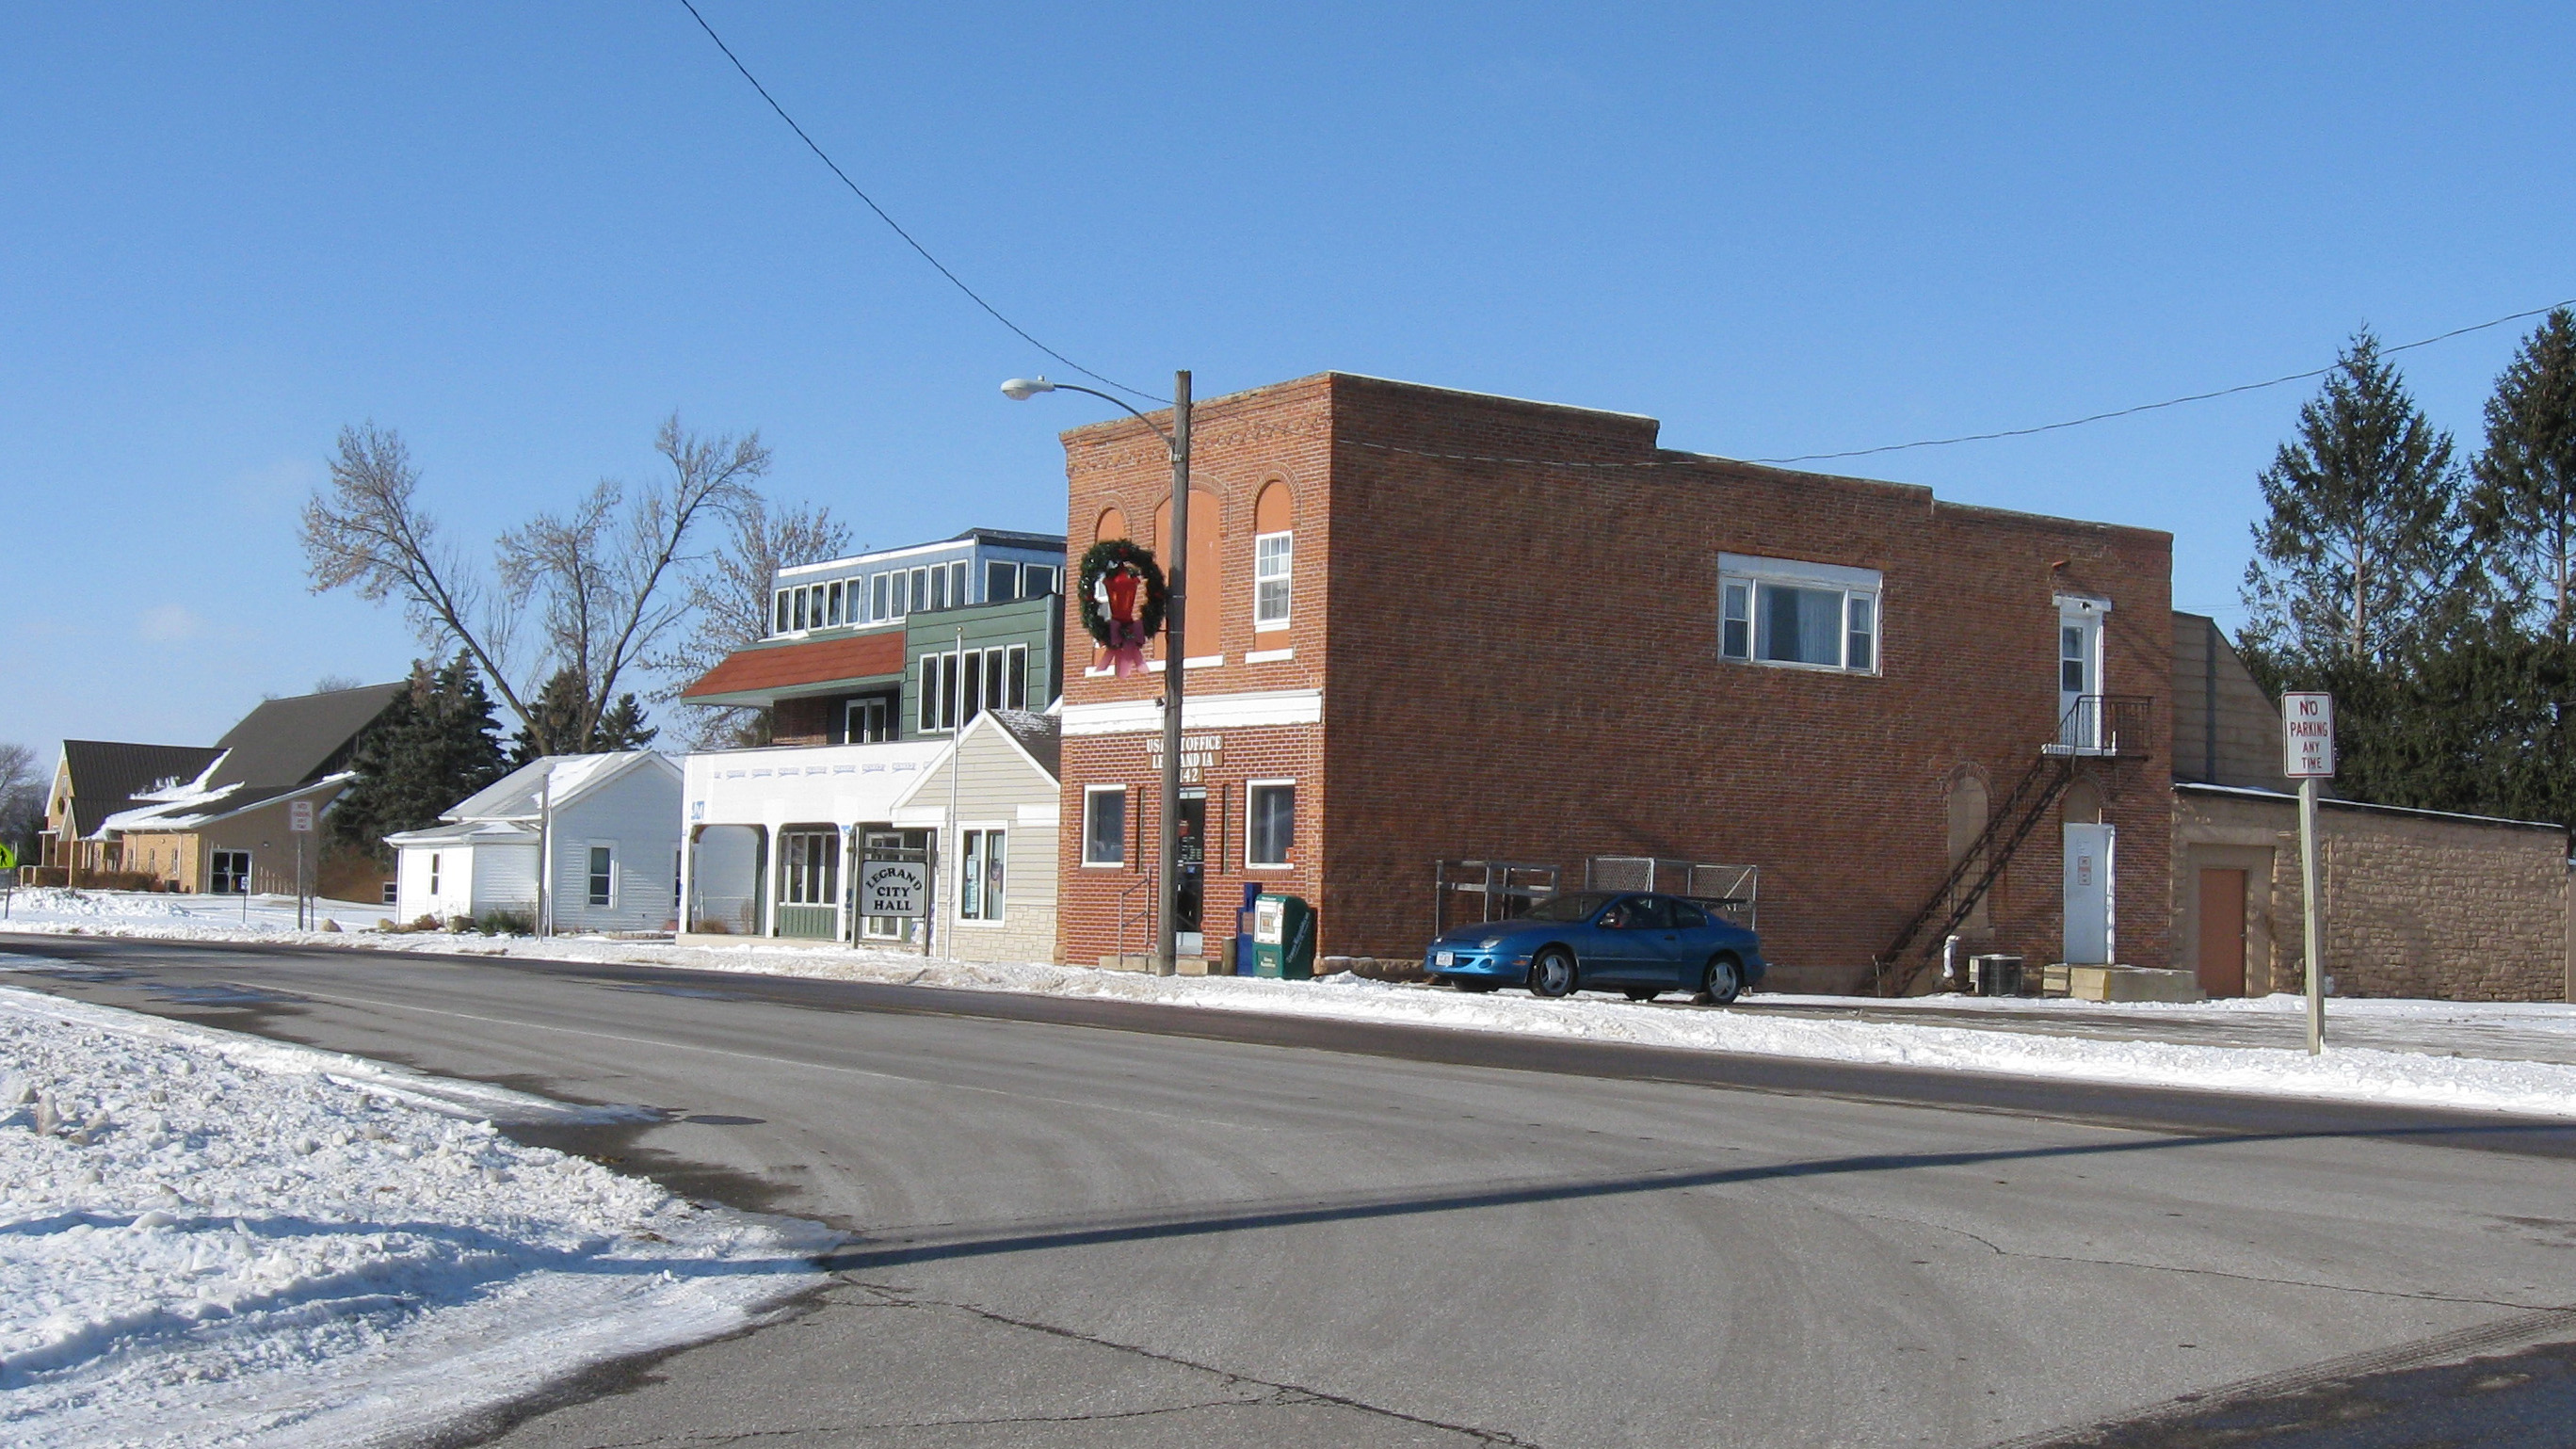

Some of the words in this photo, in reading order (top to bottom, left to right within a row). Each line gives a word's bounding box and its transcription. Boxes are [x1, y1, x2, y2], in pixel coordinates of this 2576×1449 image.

[2299, 700, 2319, 716] NO
[2290, 721, 2328, 737] PARKING
[1146, 738, 1160, 753] US
[1186, 735, 1222, 751] OFFICE
[2302, 741, 2320, 753] ANY
[1151, 753, 1200, 769] LEAND
[1202, 752, 1214, 767] IA
[2301, 756, 2322, 769] TIME
[865, 867, 923, 891] LEGRAND
[877, 886, 910, 897] CITY
[874, 899, 912, 911] HALL
